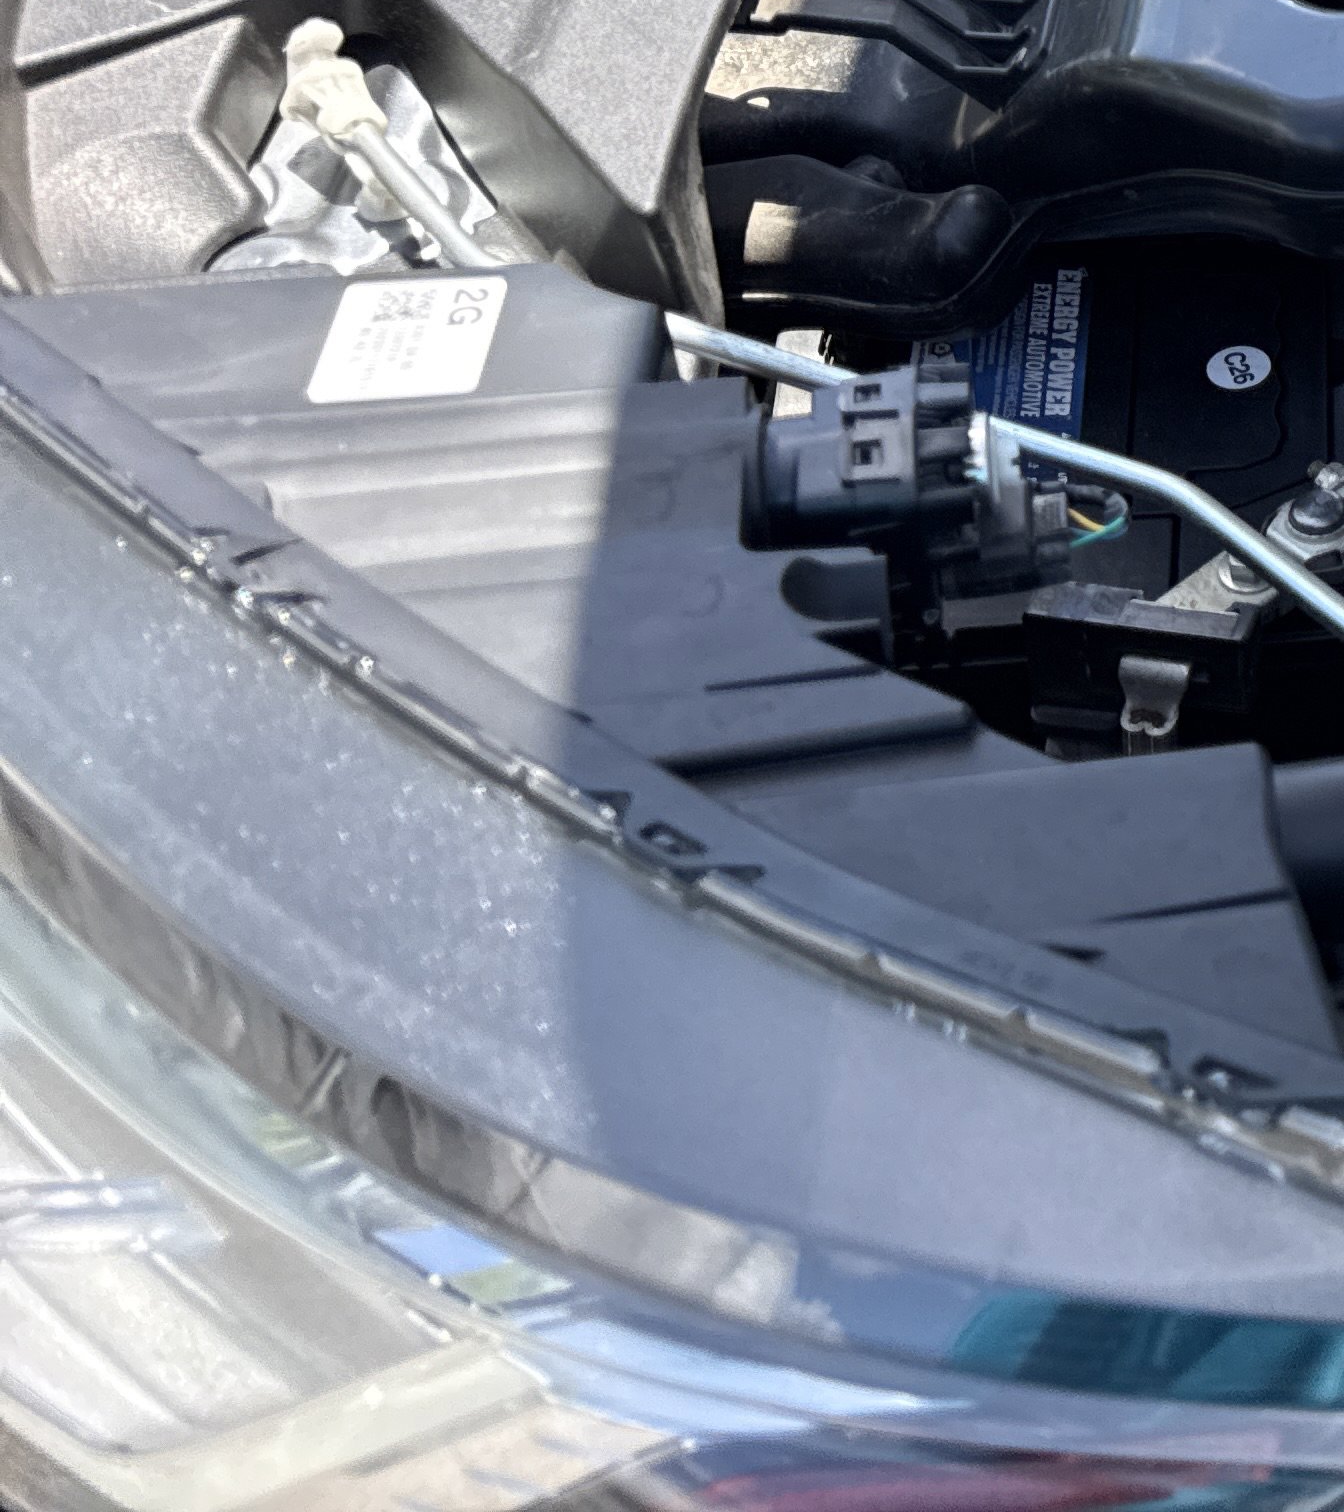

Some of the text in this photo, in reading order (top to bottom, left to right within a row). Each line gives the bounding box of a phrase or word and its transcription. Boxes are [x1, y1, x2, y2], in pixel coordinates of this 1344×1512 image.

[446, 288, 489, 326] 2G
[1046, 269, 1081, 417] ENERGY POWER
[1020, 283, 1052, 418] EXTREME AUTOMOTIVE
[1224, 352, 1256, 384] C26
